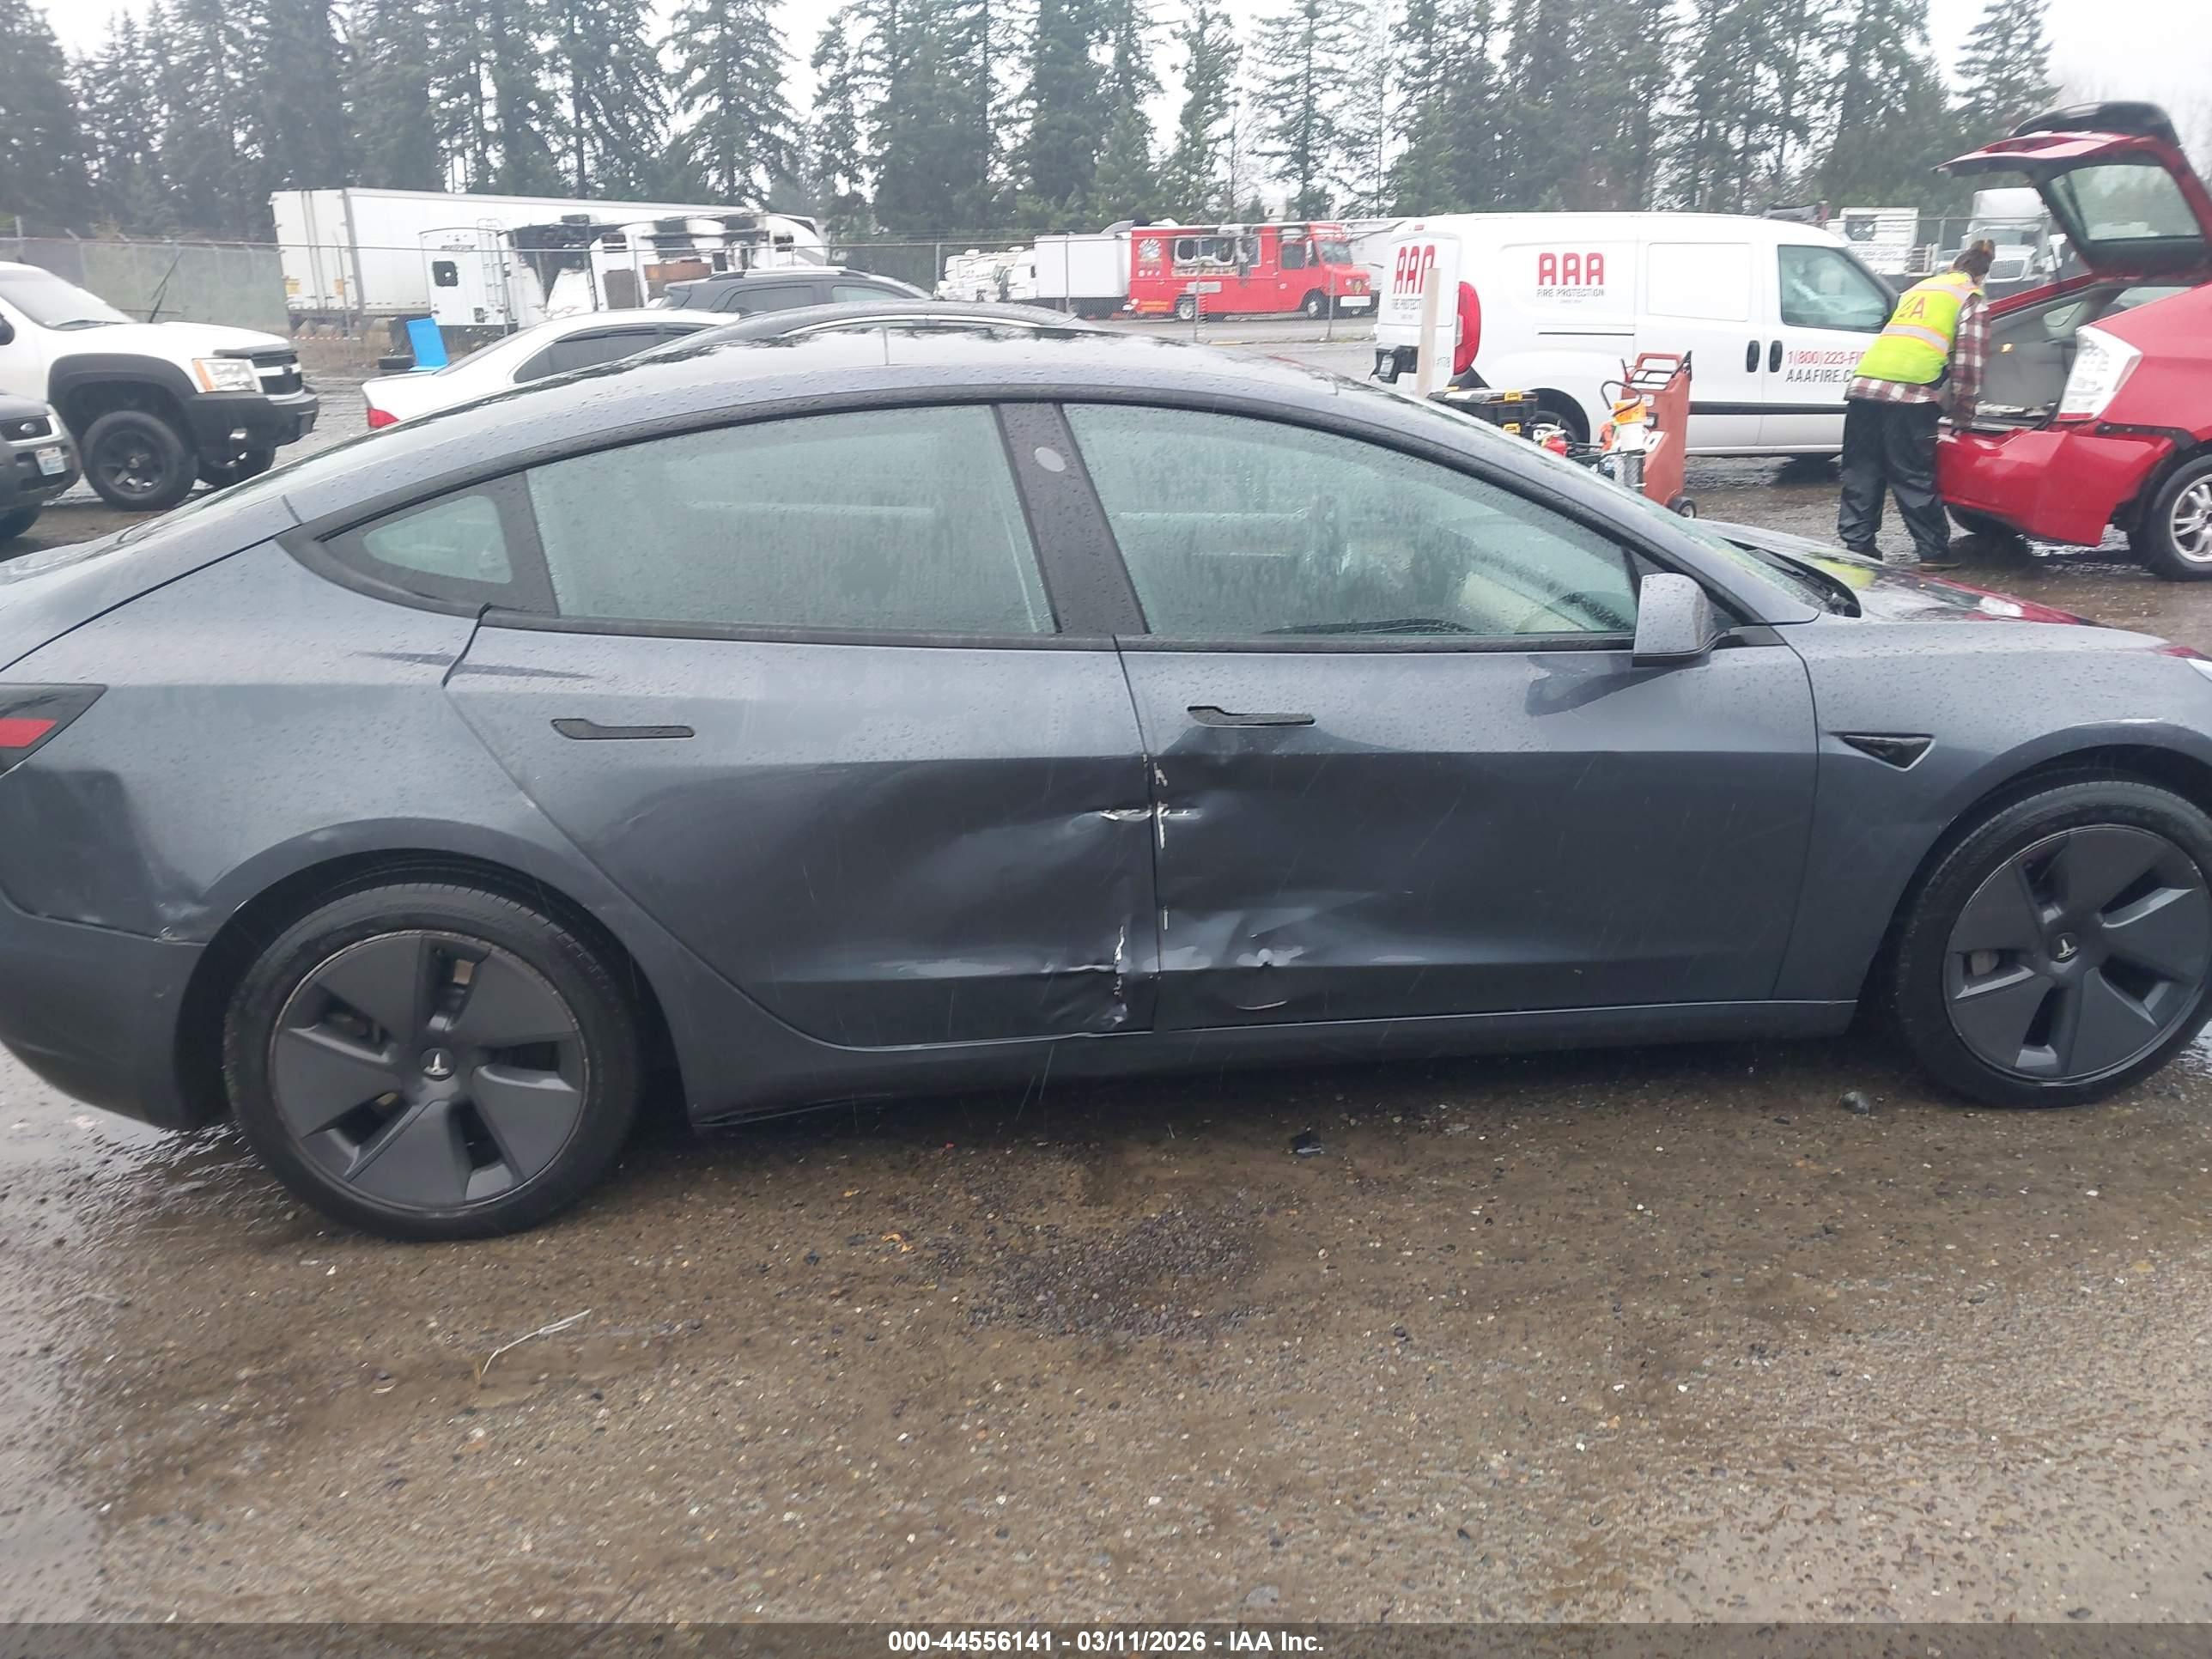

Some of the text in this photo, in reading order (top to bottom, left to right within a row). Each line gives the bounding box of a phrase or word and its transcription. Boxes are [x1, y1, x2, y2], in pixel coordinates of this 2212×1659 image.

[1538, 252, 1604, 285] AAA
[1536, 288, 1605, 297] FIRE PROTECTION
